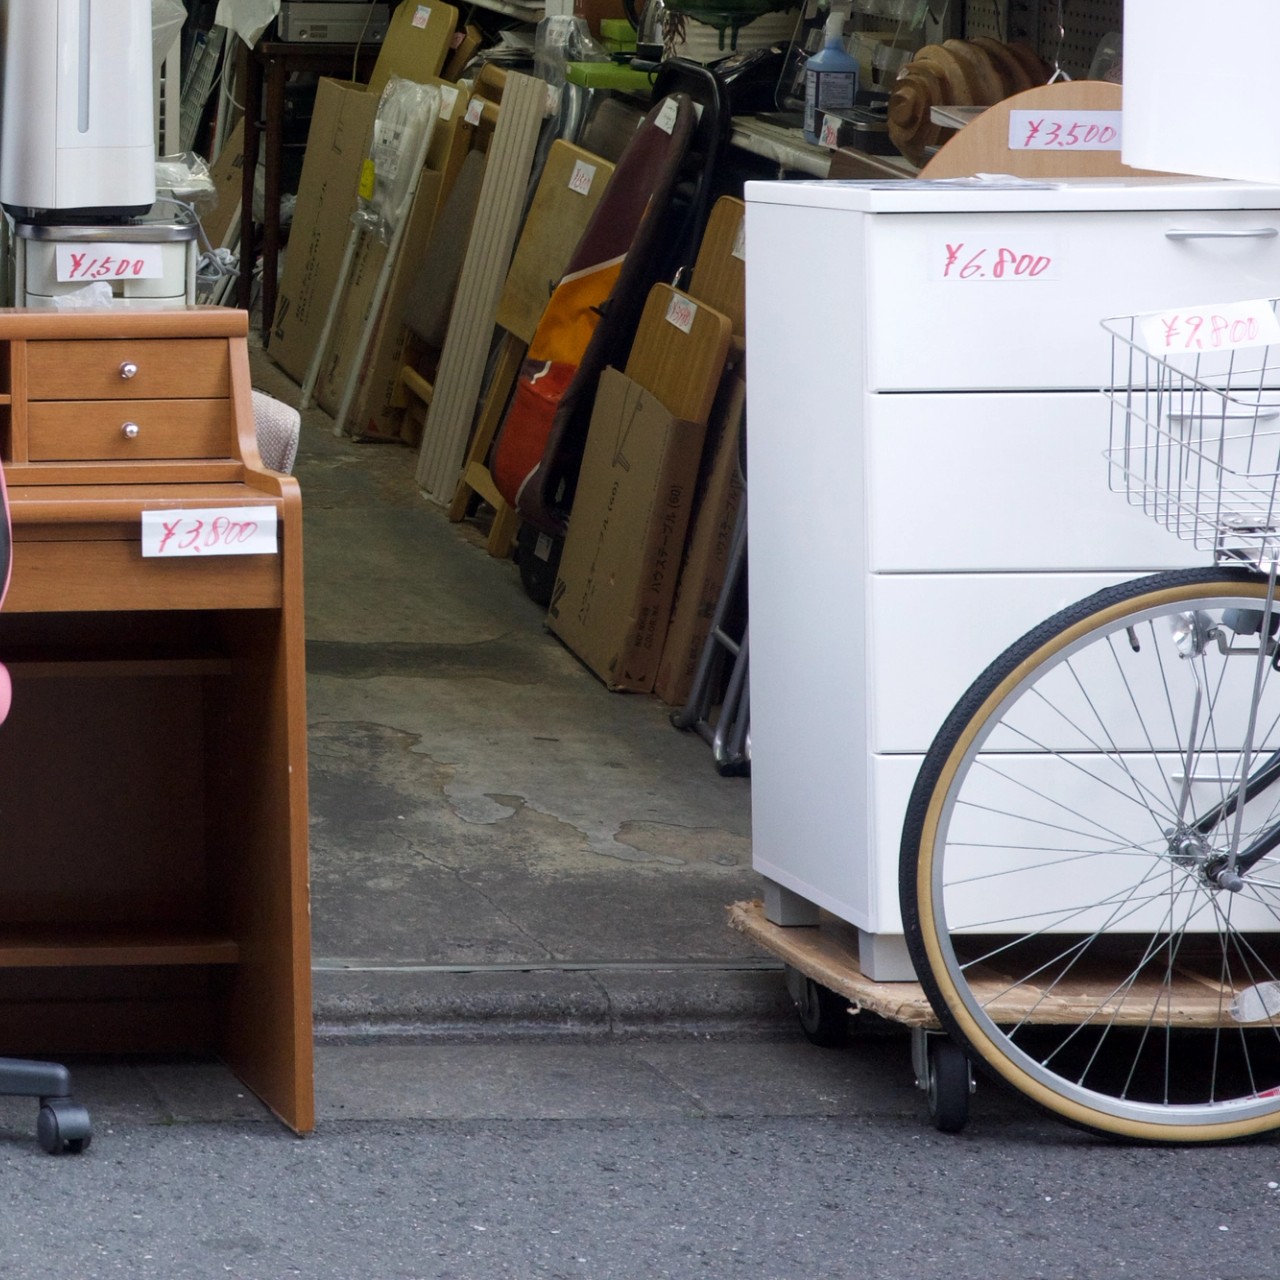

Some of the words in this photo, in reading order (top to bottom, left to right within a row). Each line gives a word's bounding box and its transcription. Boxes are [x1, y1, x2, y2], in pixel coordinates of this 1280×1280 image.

[1023, 118, 1118, 148] ¥3,500
[69, 252, 145, 280] ¥1,500
[1160, 315, 1260, 350] ¥9,800
[157, 515, 260, 554] ¥3,800
